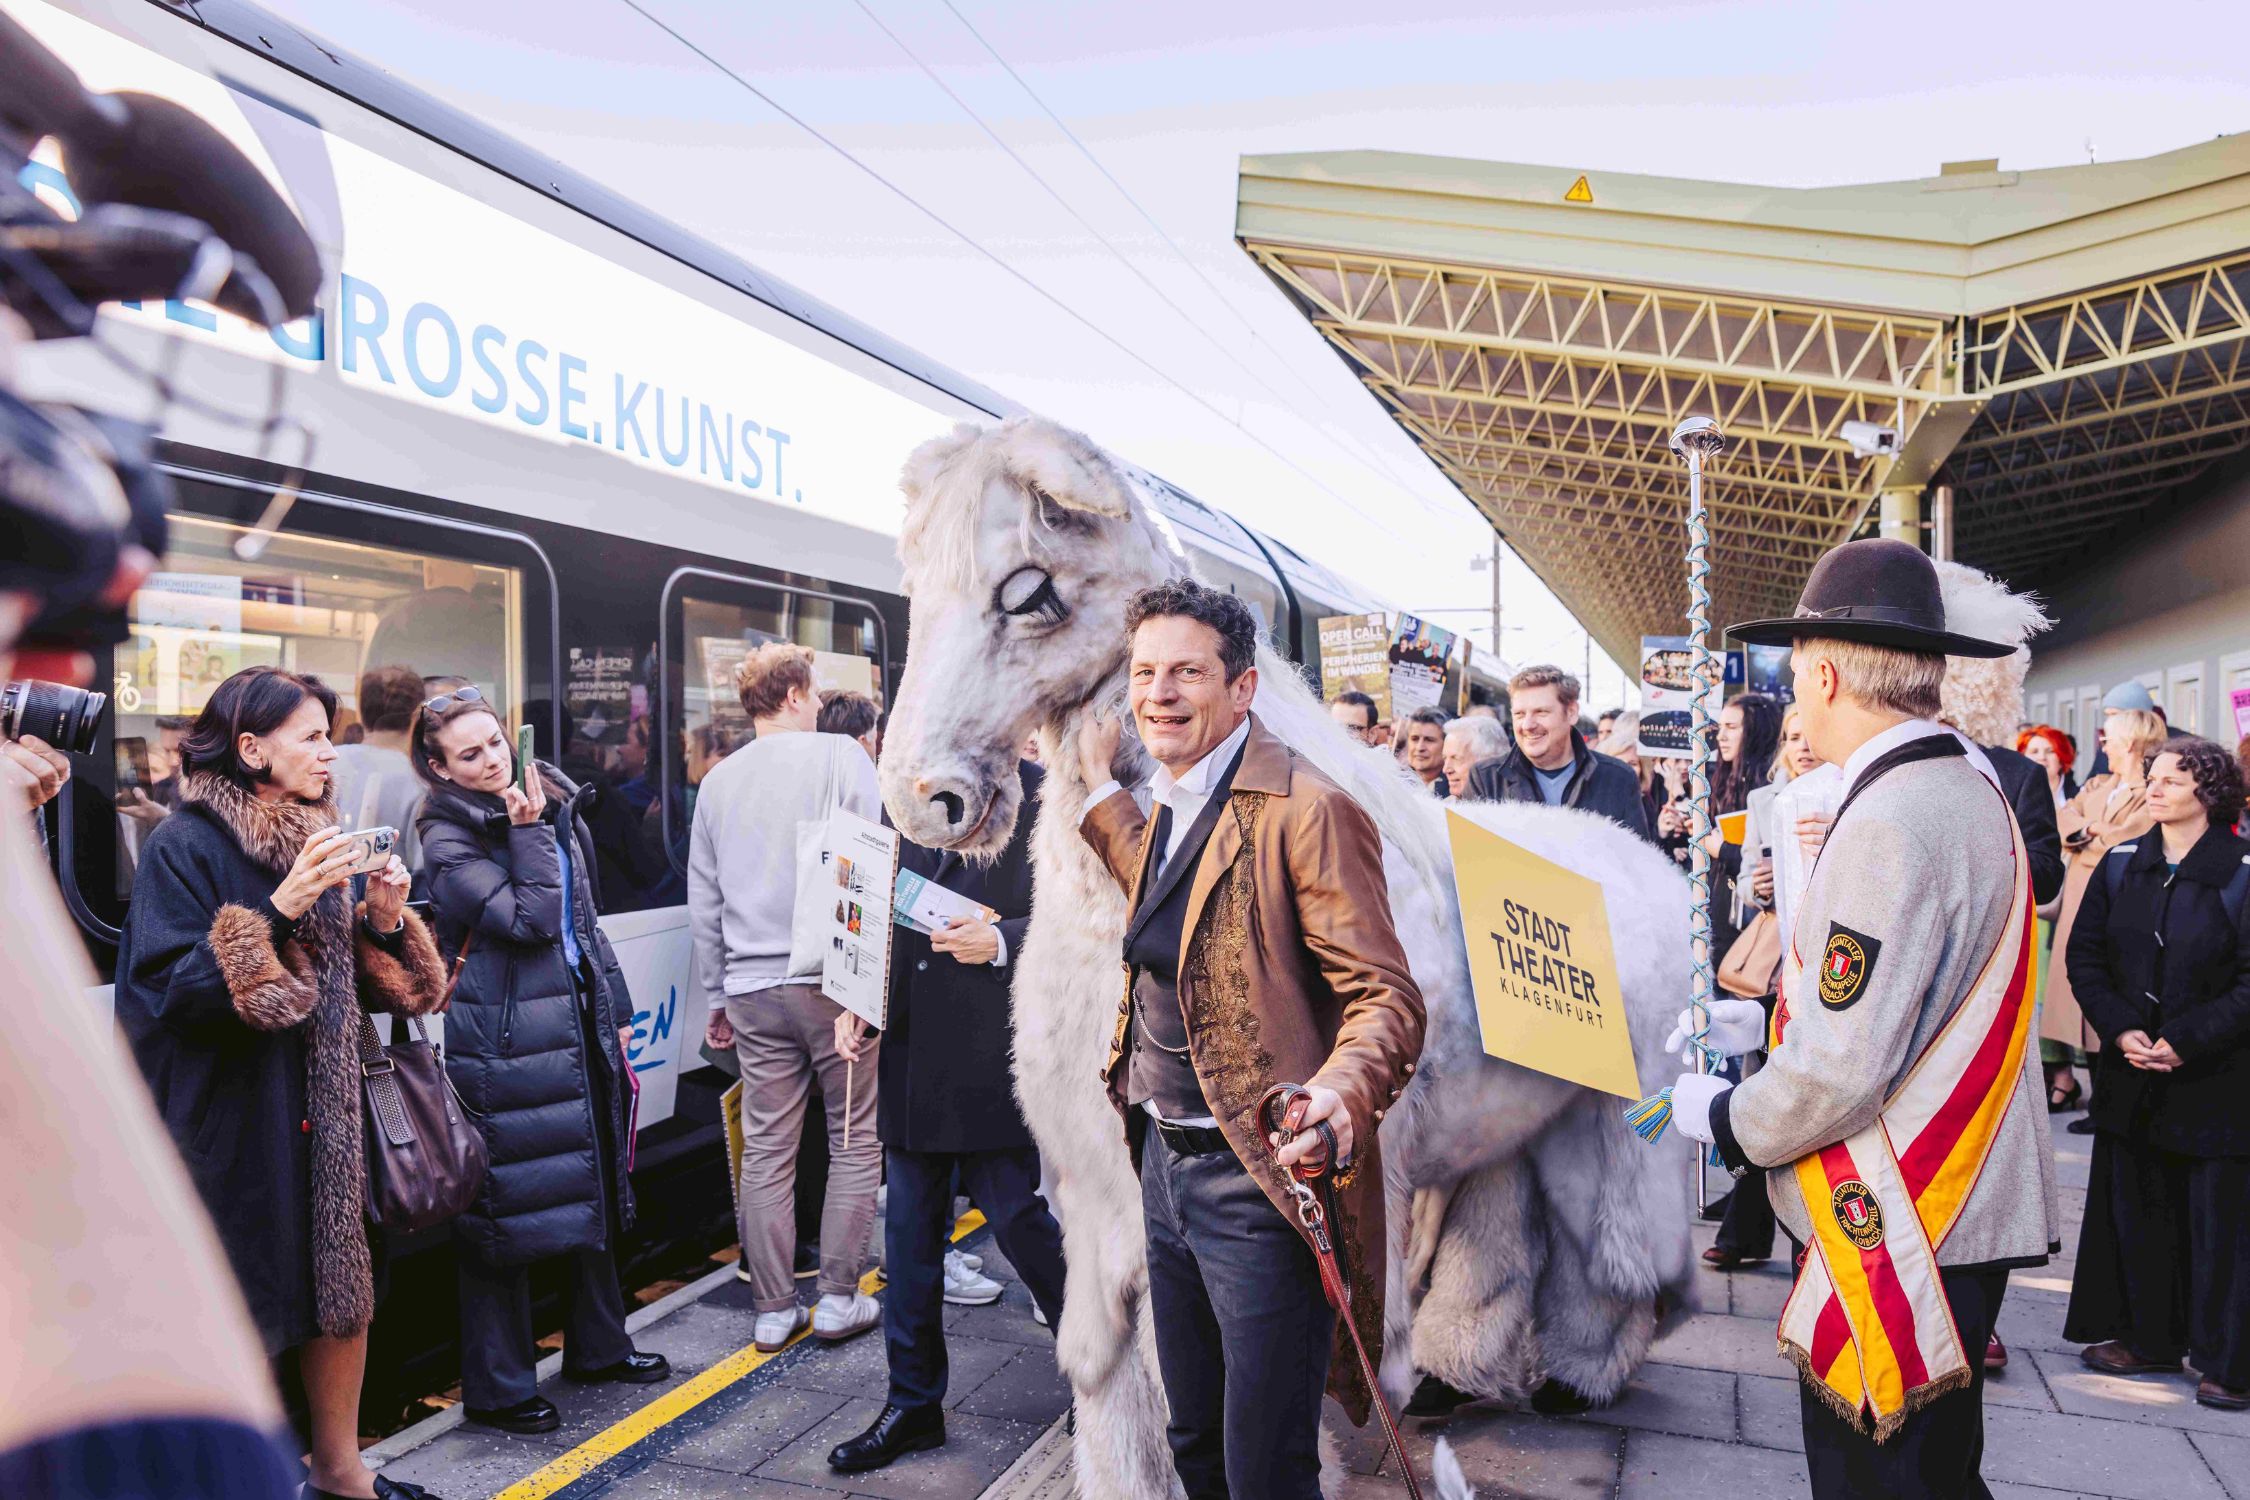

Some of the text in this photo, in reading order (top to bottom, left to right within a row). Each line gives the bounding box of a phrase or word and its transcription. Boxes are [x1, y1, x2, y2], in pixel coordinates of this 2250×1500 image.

[1320, 626, 1383, 642] OPEN CALL
[1322, 650, 1387, 667] PERIPHERIEN
[1727, 657, 1738, 678] 1
[1327, 666, 1341, 678] IM
[1342, 663, 1383, 677] WANDEL
[1503, 898, 1571, 957] STADT
[1490, 931, 1600, 1007] THEATER
[1500, 977, 1603, 1029] KLAGENFURT
[1834, 1183, 1868, 1208] JAUNTALER
[1838, 1204, 1879, 1237] TRACHTENKAPELLE
[1854, 1227, 1882, 1247] LOIBACH
